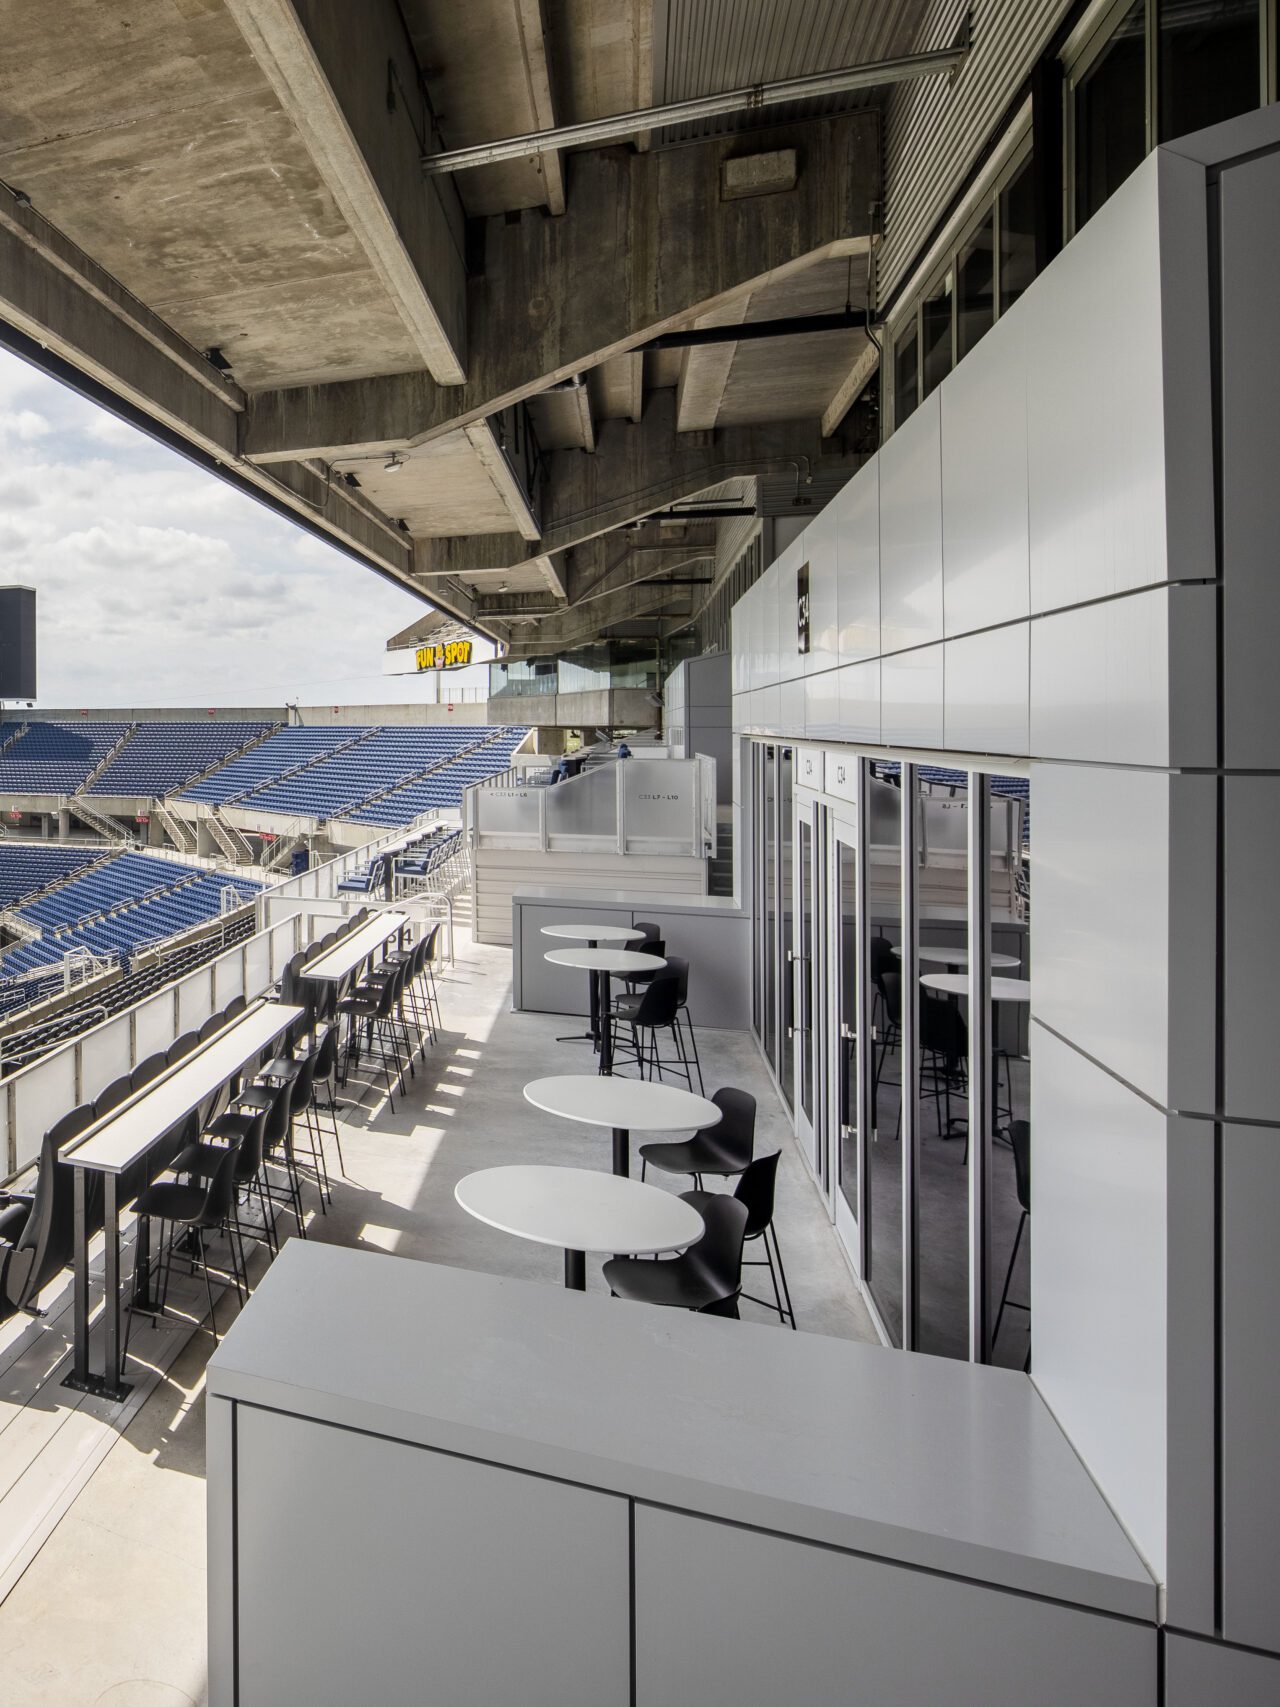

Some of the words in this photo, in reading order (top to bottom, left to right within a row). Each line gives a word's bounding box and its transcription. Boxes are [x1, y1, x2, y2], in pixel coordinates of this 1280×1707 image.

[799, 593, 809, 627] C34
[416, 646, 435, 671] FUN
[445, 640, 472, 665] SPOT
